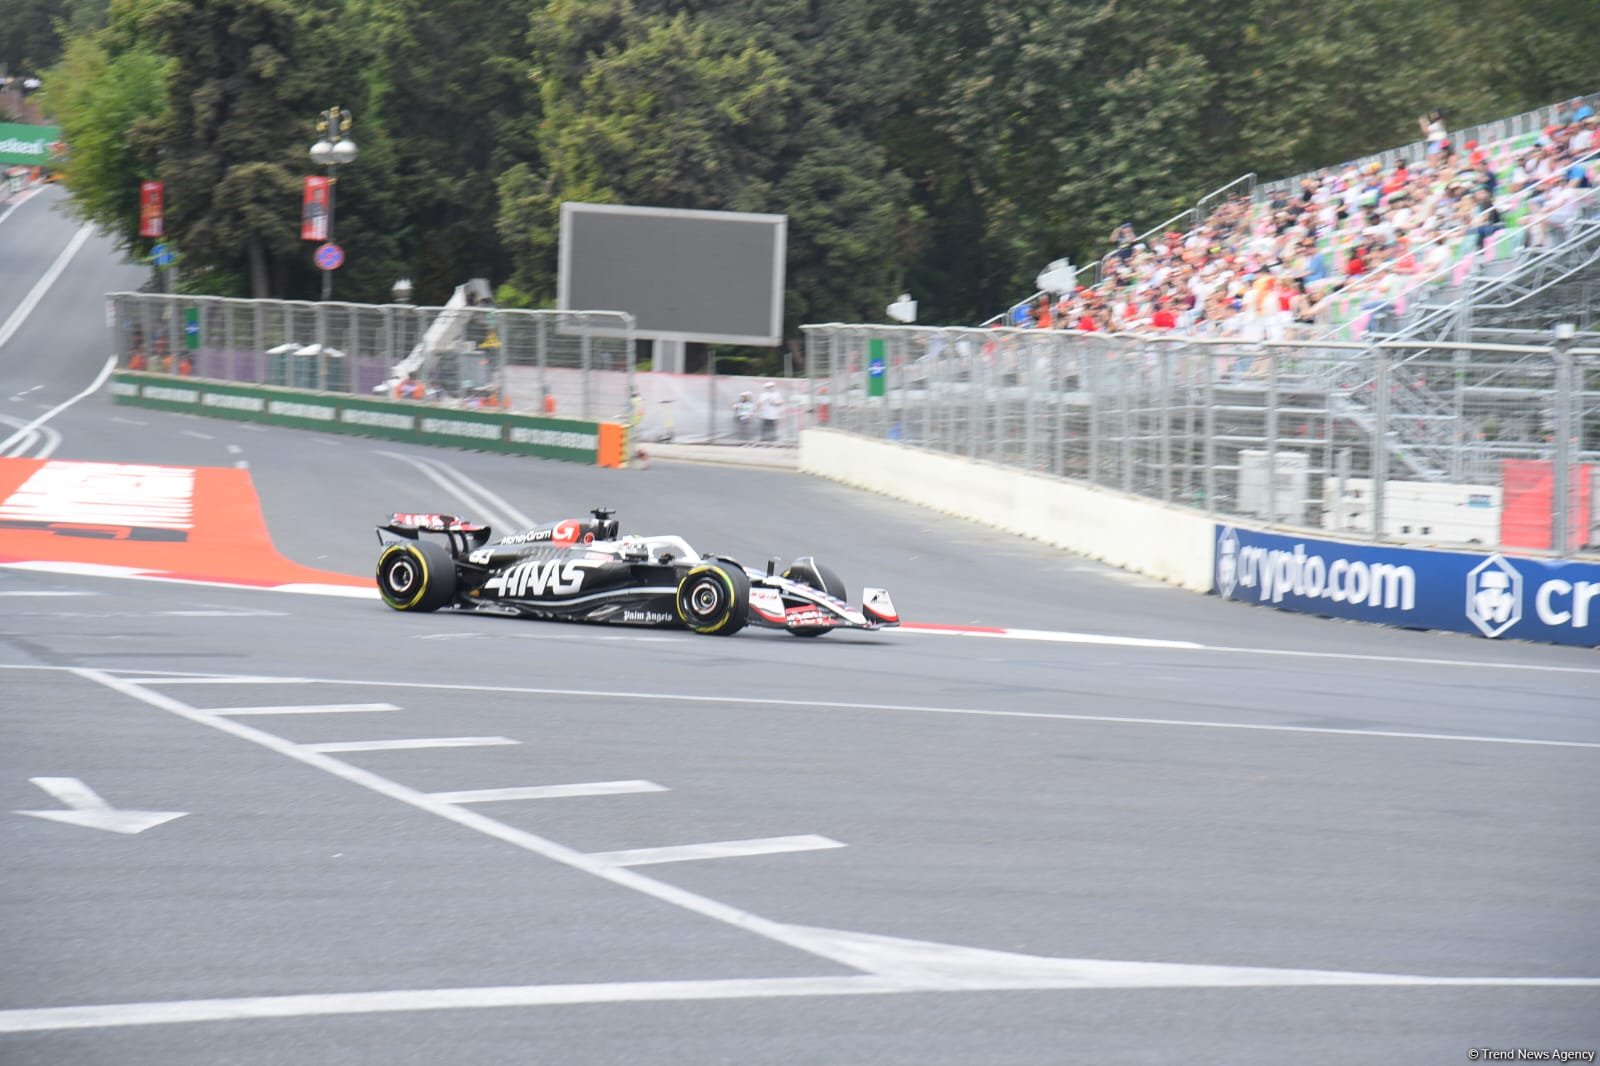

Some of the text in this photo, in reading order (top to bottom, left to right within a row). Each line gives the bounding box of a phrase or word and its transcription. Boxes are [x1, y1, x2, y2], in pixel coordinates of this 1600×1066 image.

[501, 529, 551, 545] MoneyGram
[485, 558, 606, 597] HAAS
[1239, 543, 1416, 611] crypto.com
[623, 610, 672, 623] Palm Angels
